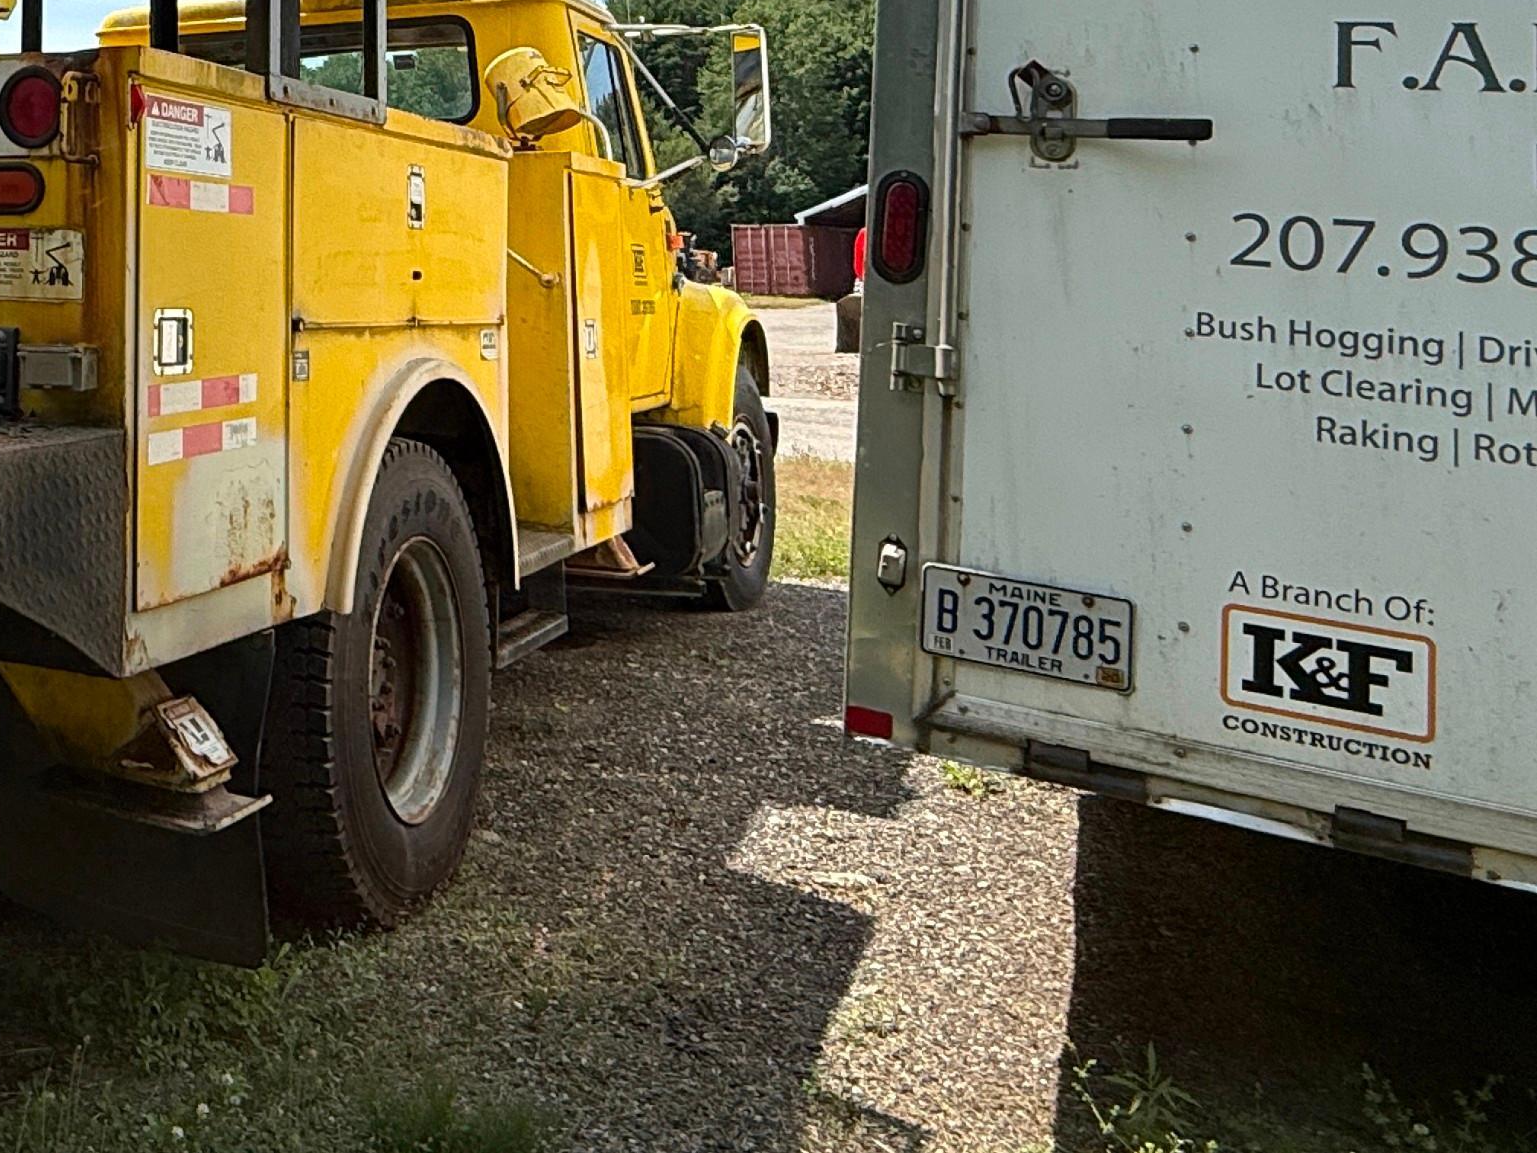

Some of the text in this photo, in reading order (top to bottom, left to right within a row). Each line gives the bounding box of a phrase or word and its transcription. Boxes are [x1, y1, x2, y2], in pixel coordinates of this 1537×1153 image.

[1332, 20, 1537, 93] F.A.
[161, 101, 199, 123] DANGER
[1229, 212, 1537, 289] 207.938
[1195, 311, 1276, 344] Bush
[1289, 319, 1444, 367] Hogging
[1255, 362, 1312, 394] Lot
[1320, 368, 1473, 417] Clearing
[1316, 415, 1439, 463] Raking
[988, 582, 1063, 608] MAINE
[1227, 570, 1435, 627] A Branch Of:
[934, 635, 952, 651] FEB
[936, 587, 1123, 666] B 370785
[983, 645, 1064, 674] TRAILER
[1241, 622, 1414, 717] K&F
[1222, 714, 1433, 771] CONSTRUCTION
